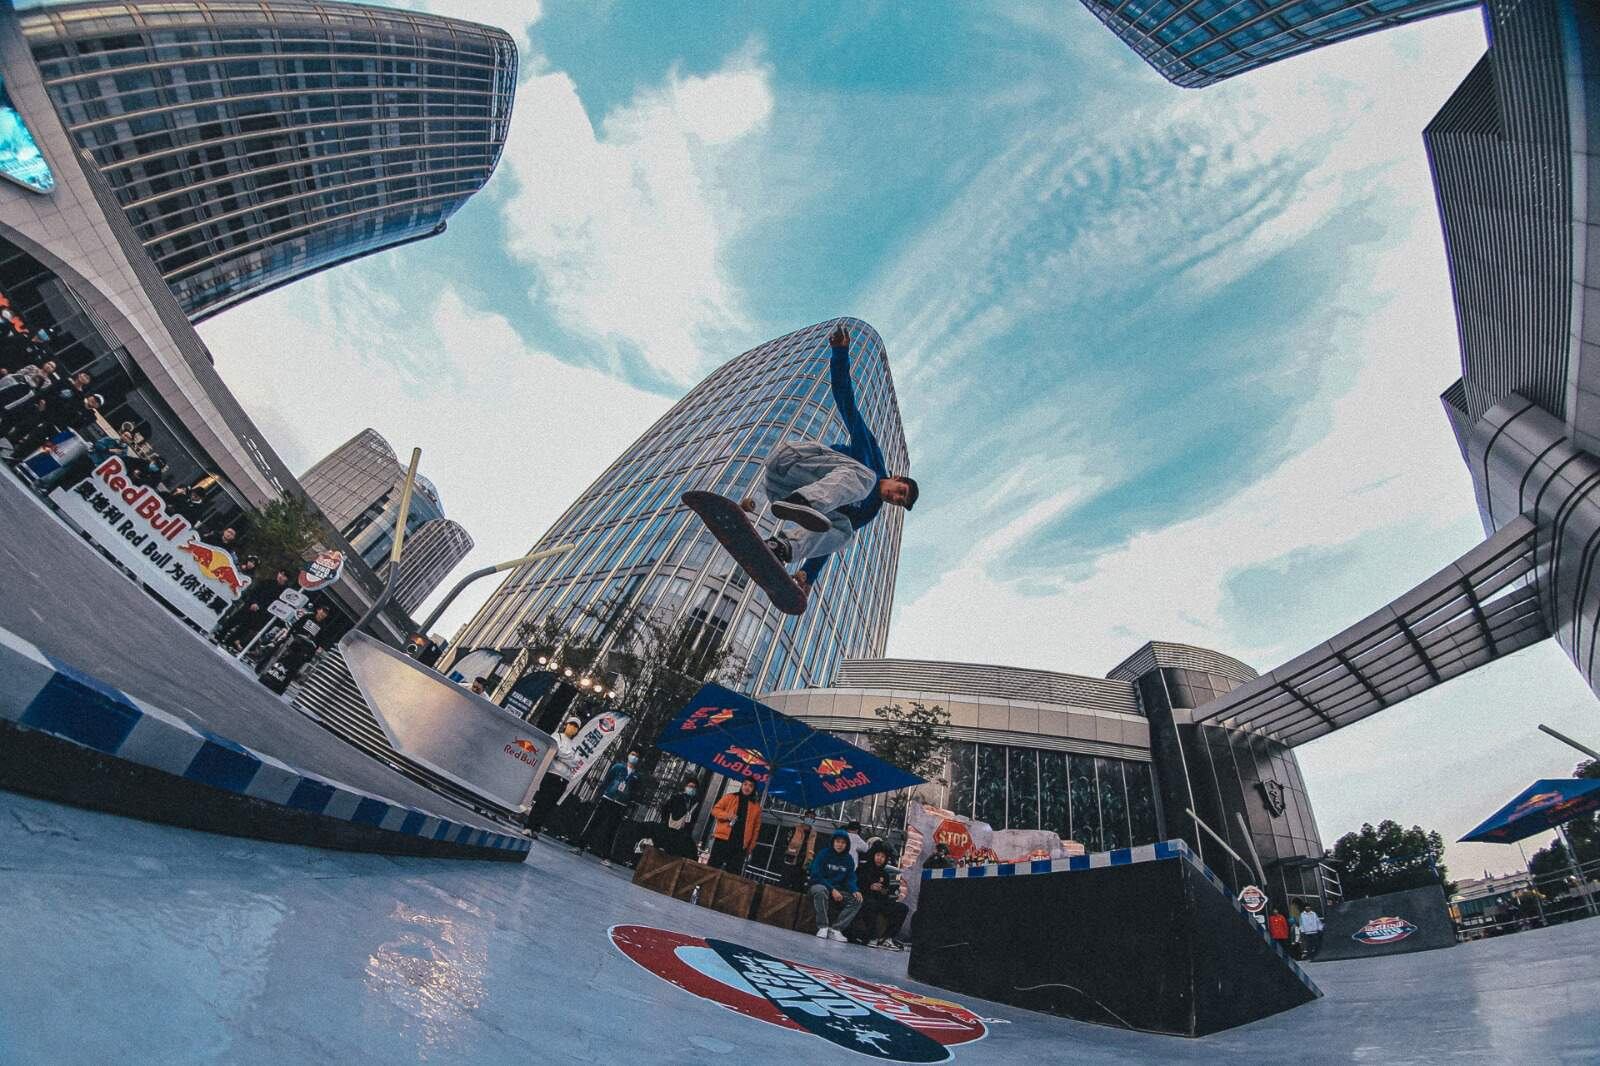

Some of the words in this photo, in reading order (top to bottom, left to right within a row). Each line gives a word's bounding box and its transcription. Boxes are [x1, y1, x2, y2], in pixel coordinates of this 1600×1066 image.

[96, 458, 149, 506] Red
[135, 495, 187, 541] Bull
[73, 480, 125, 525] 奥地利
[117, 519, 149, 547] Red
[141, 541, 173, 568] Bull
[504, 744, 522, 759] Red
[520, 752, 537, 768] Bull
[939, 831, 968, 848] STOP
[732, 953, 770, 976] THE
[753, 956, 871, 1017] MIND
[742, 971, 831, 1017] GAP
